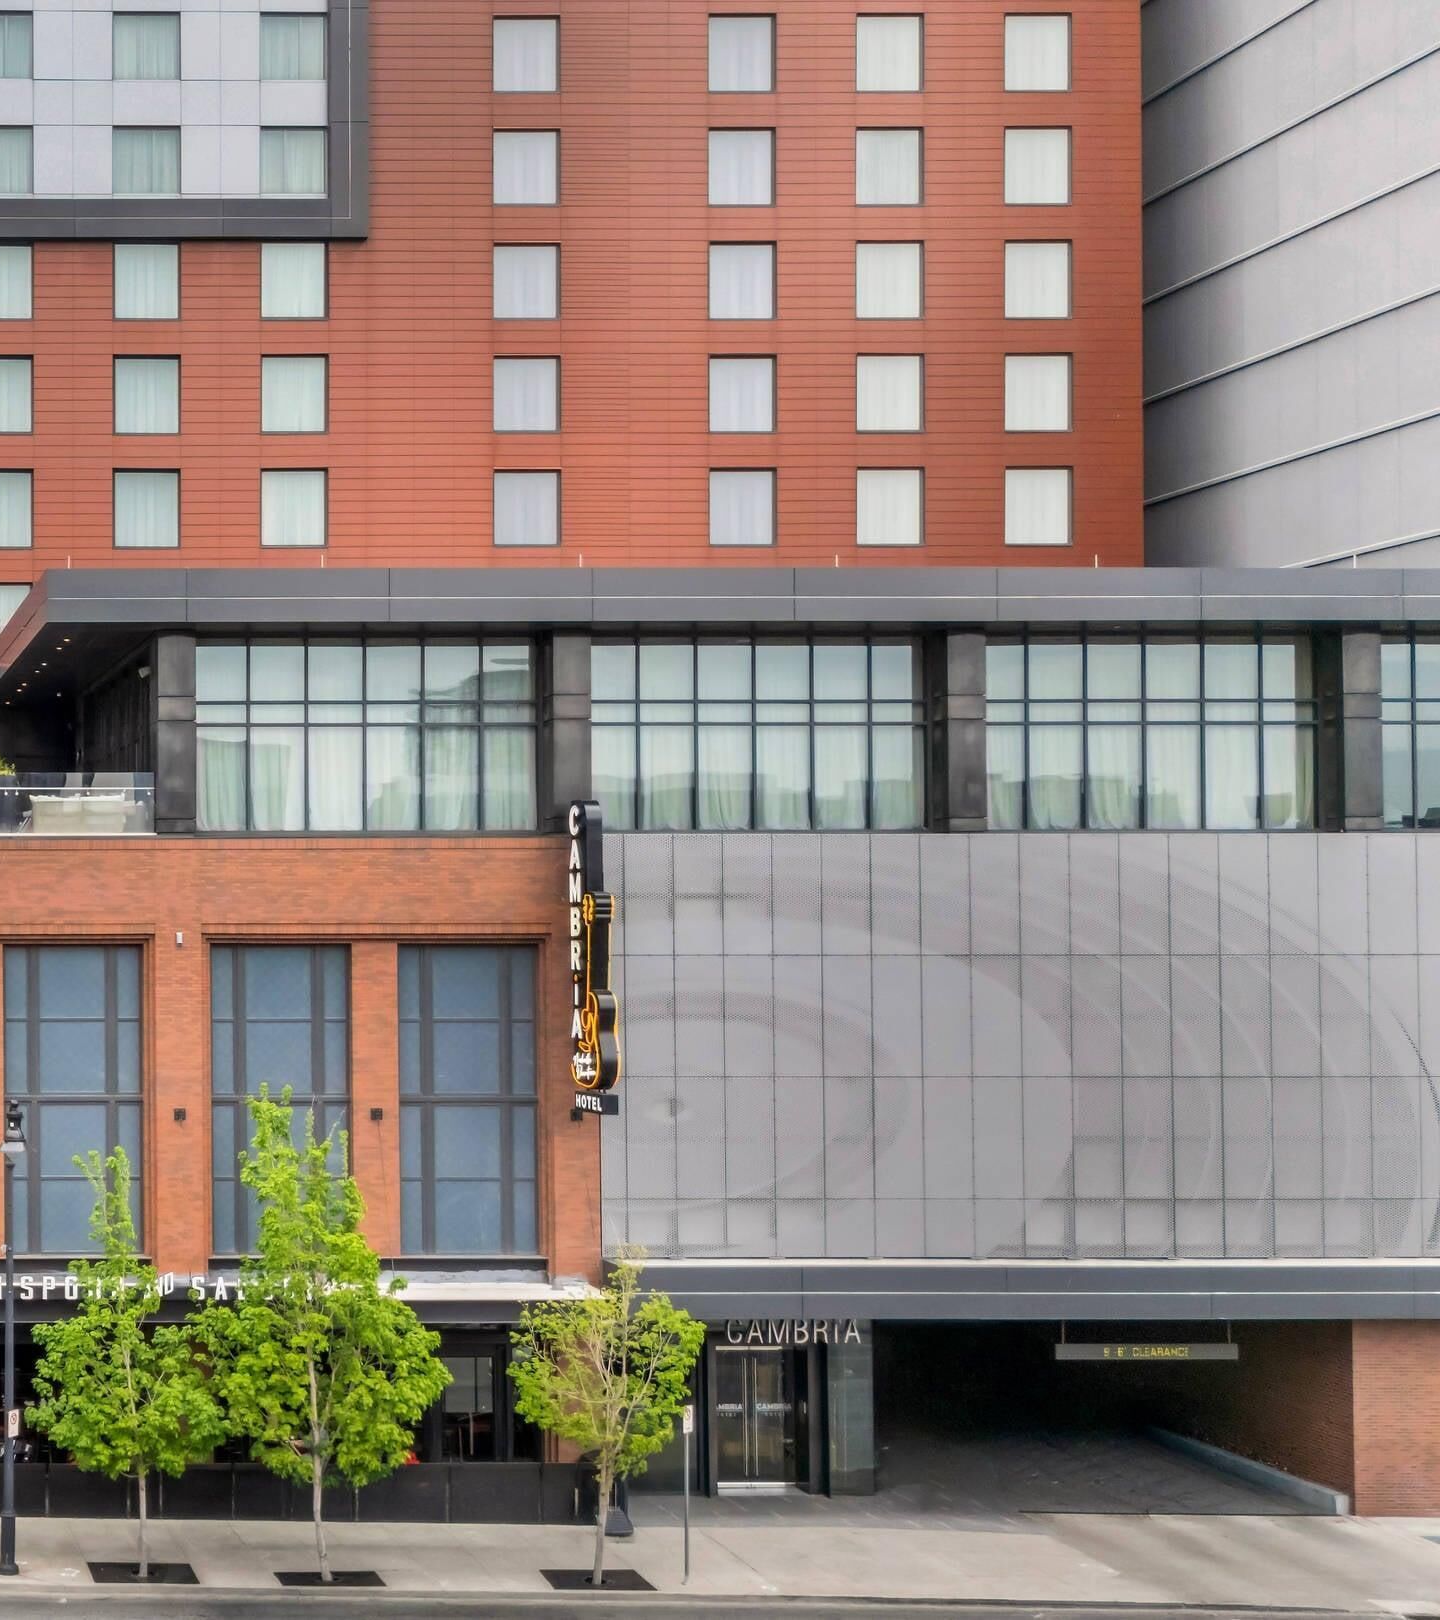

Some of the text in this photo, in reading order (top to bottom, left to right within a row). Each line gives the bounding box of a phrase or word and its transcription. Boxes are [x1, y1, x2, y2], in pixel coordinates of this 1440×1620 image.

[569, 804, 583, 1040] CAMBRIA
[575, 1093, 603, 1113] HOTEL
[727, 1319, 862, 1344] CAMBRIA
[1132, 1346, 1189, 1357] CLEARANCE
